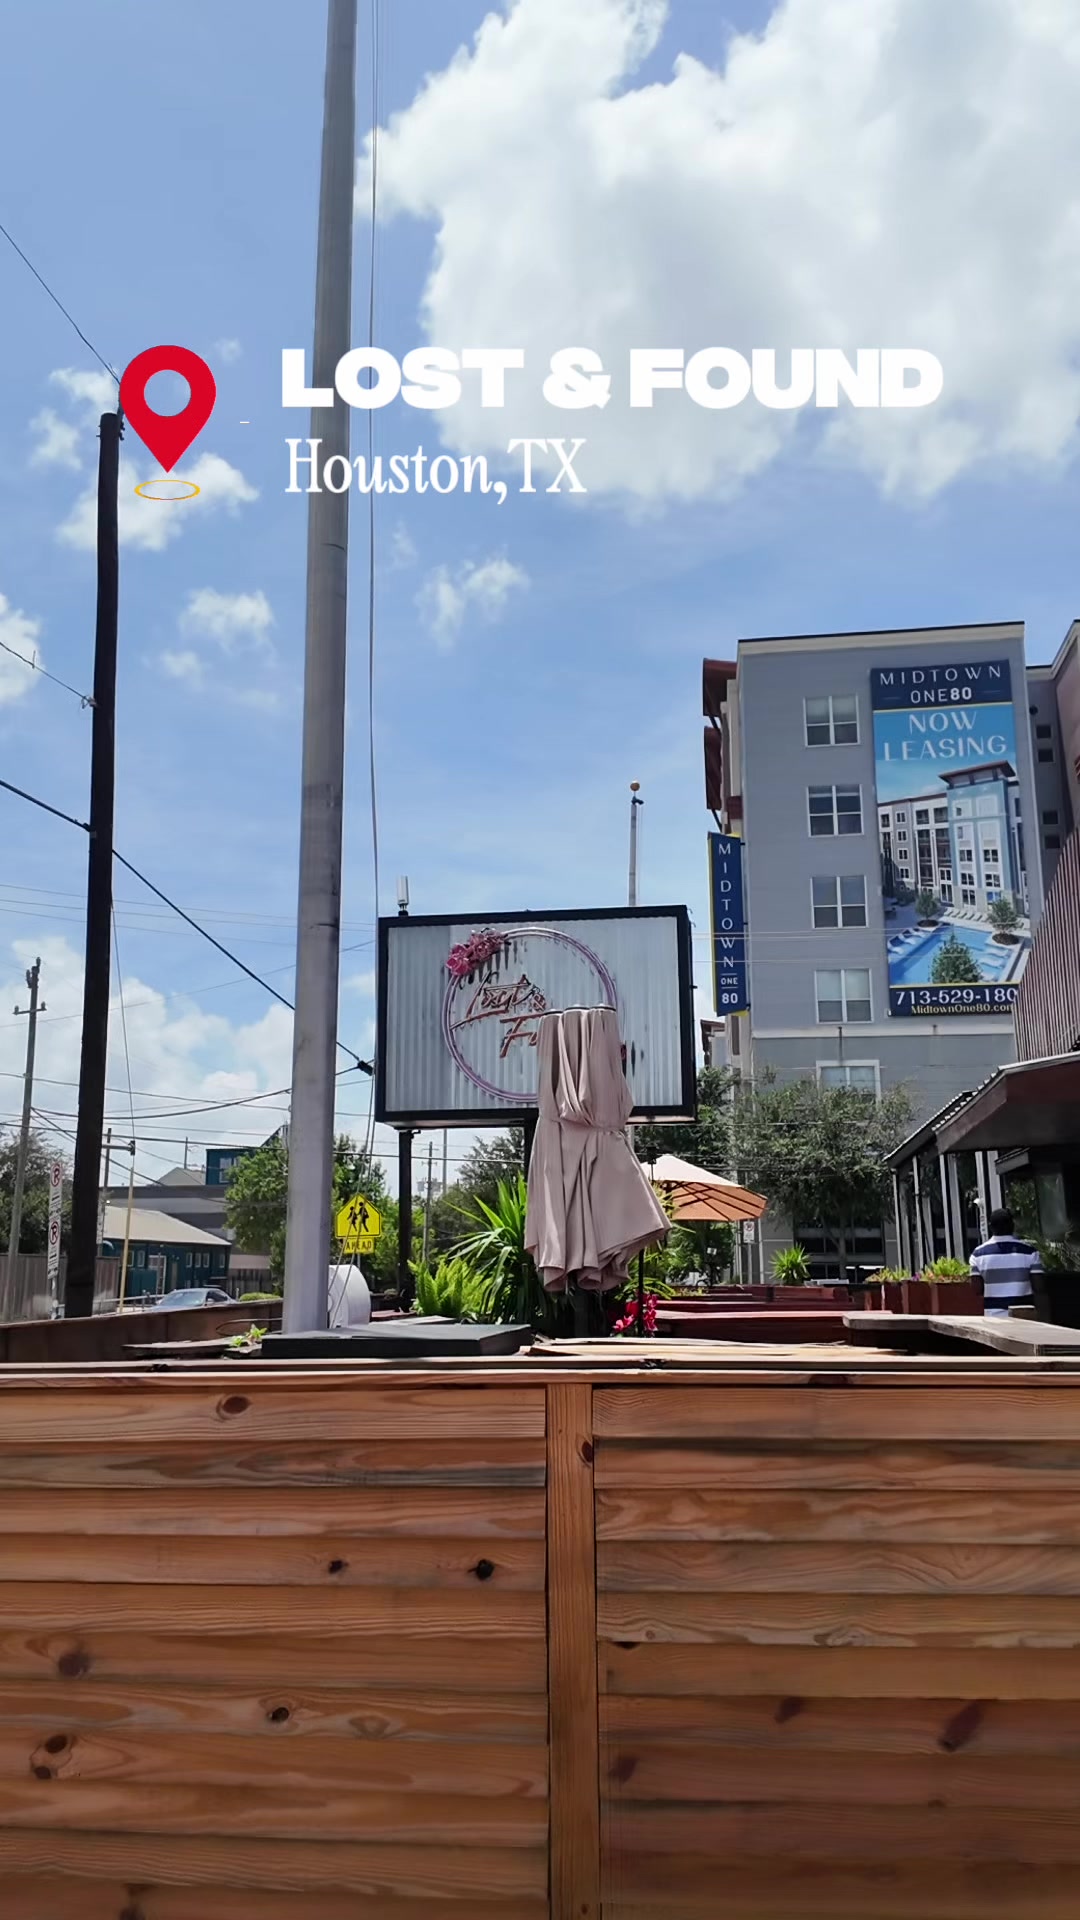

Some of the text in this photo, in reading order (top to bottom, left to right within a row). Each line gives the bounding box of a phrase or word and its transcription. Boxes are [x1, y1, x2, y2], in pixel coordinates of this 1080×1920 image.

[880, 665, 1001, 685] MIDTOWN
[910, 687, 972, 703] ONE80
[908, 711, 977, 734] NOW
[884, 735, 1007, 761] LEASING
[718, 843, 736, 968] MIDTOWN
[720, 977, 738, 985] ONE
[721, 993, 738, 1004] 80
[896, 988, 1018, 1005] 713-529-180
